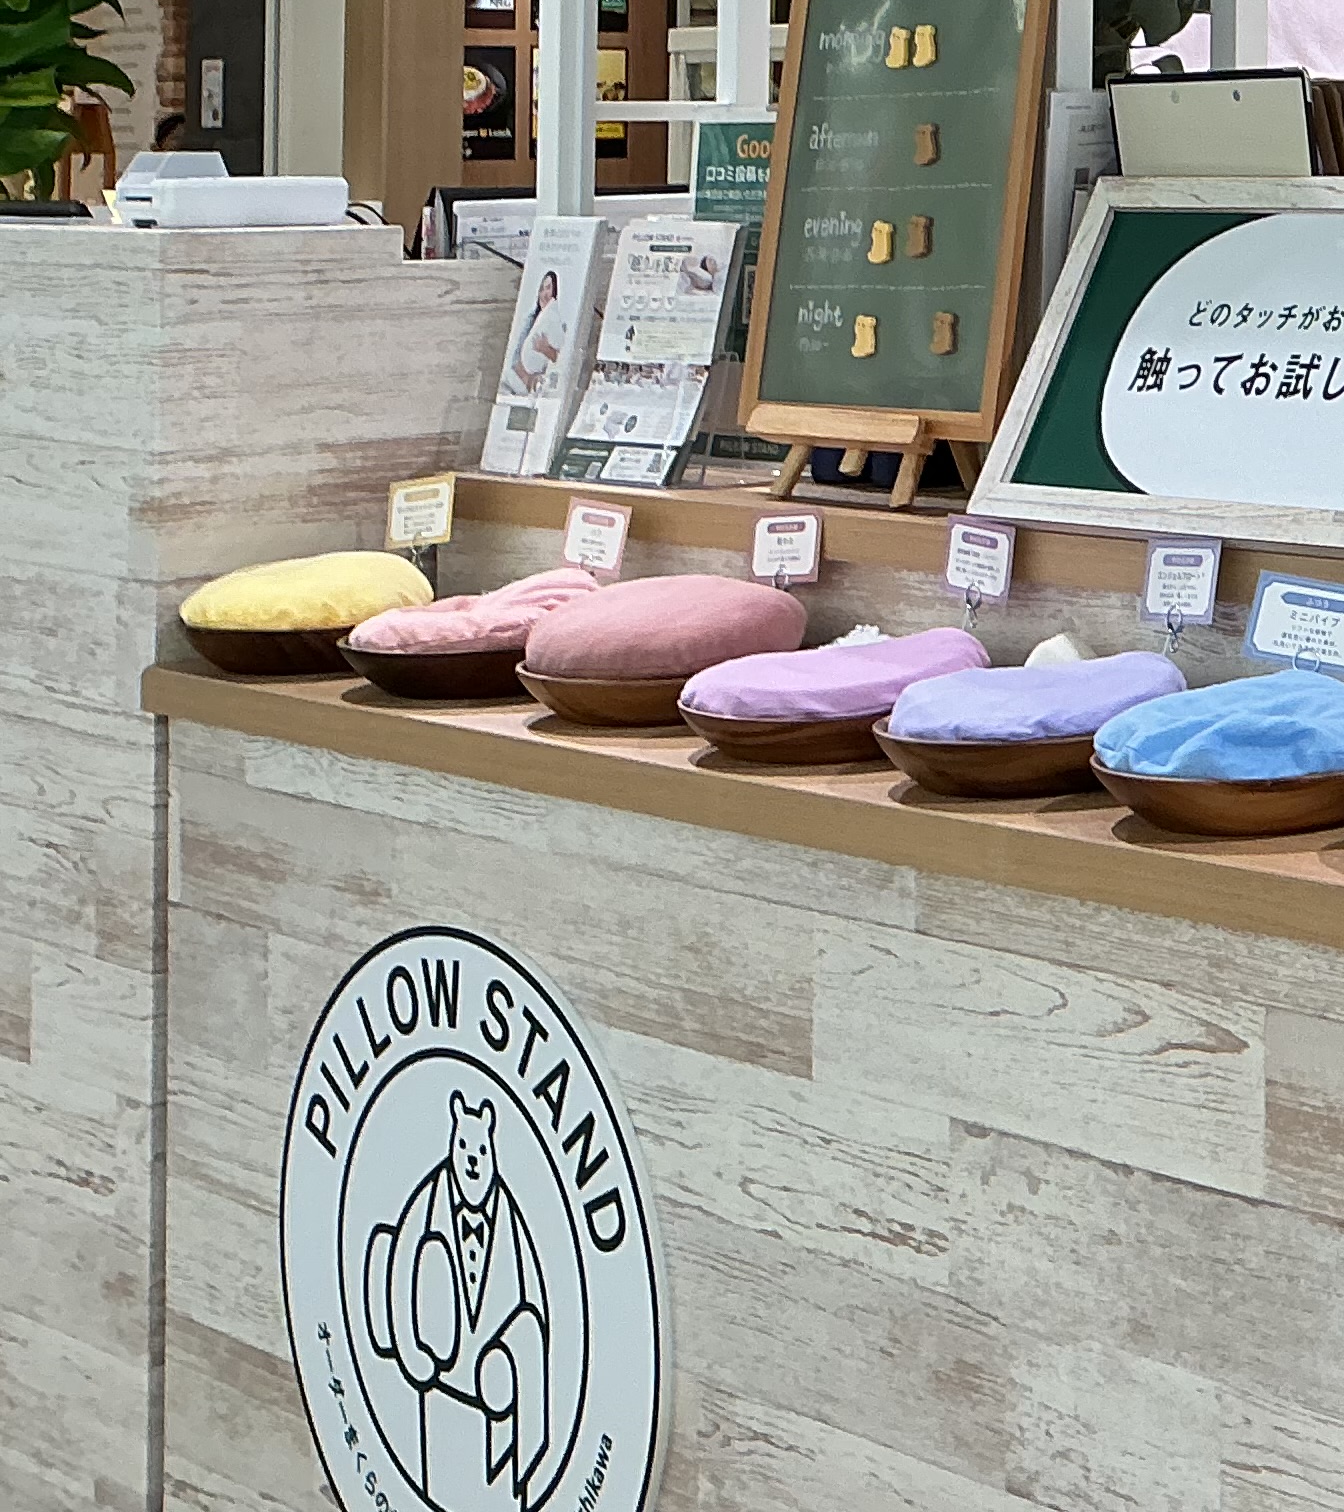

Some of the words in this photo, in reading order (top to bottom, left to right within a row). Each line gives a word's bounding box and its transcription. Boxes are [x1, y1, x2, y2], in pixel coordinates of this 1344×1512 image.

[803, 211, 863, 247] evening
[798, 299, 843, 331] night
[305, 957, 461, 1158] PILLOW
[479, 979, 628, 1253] STAND
[317, 1321, 396, 1512] オーダーまくらの
[574, 1432, 614, 1512] hikawa
